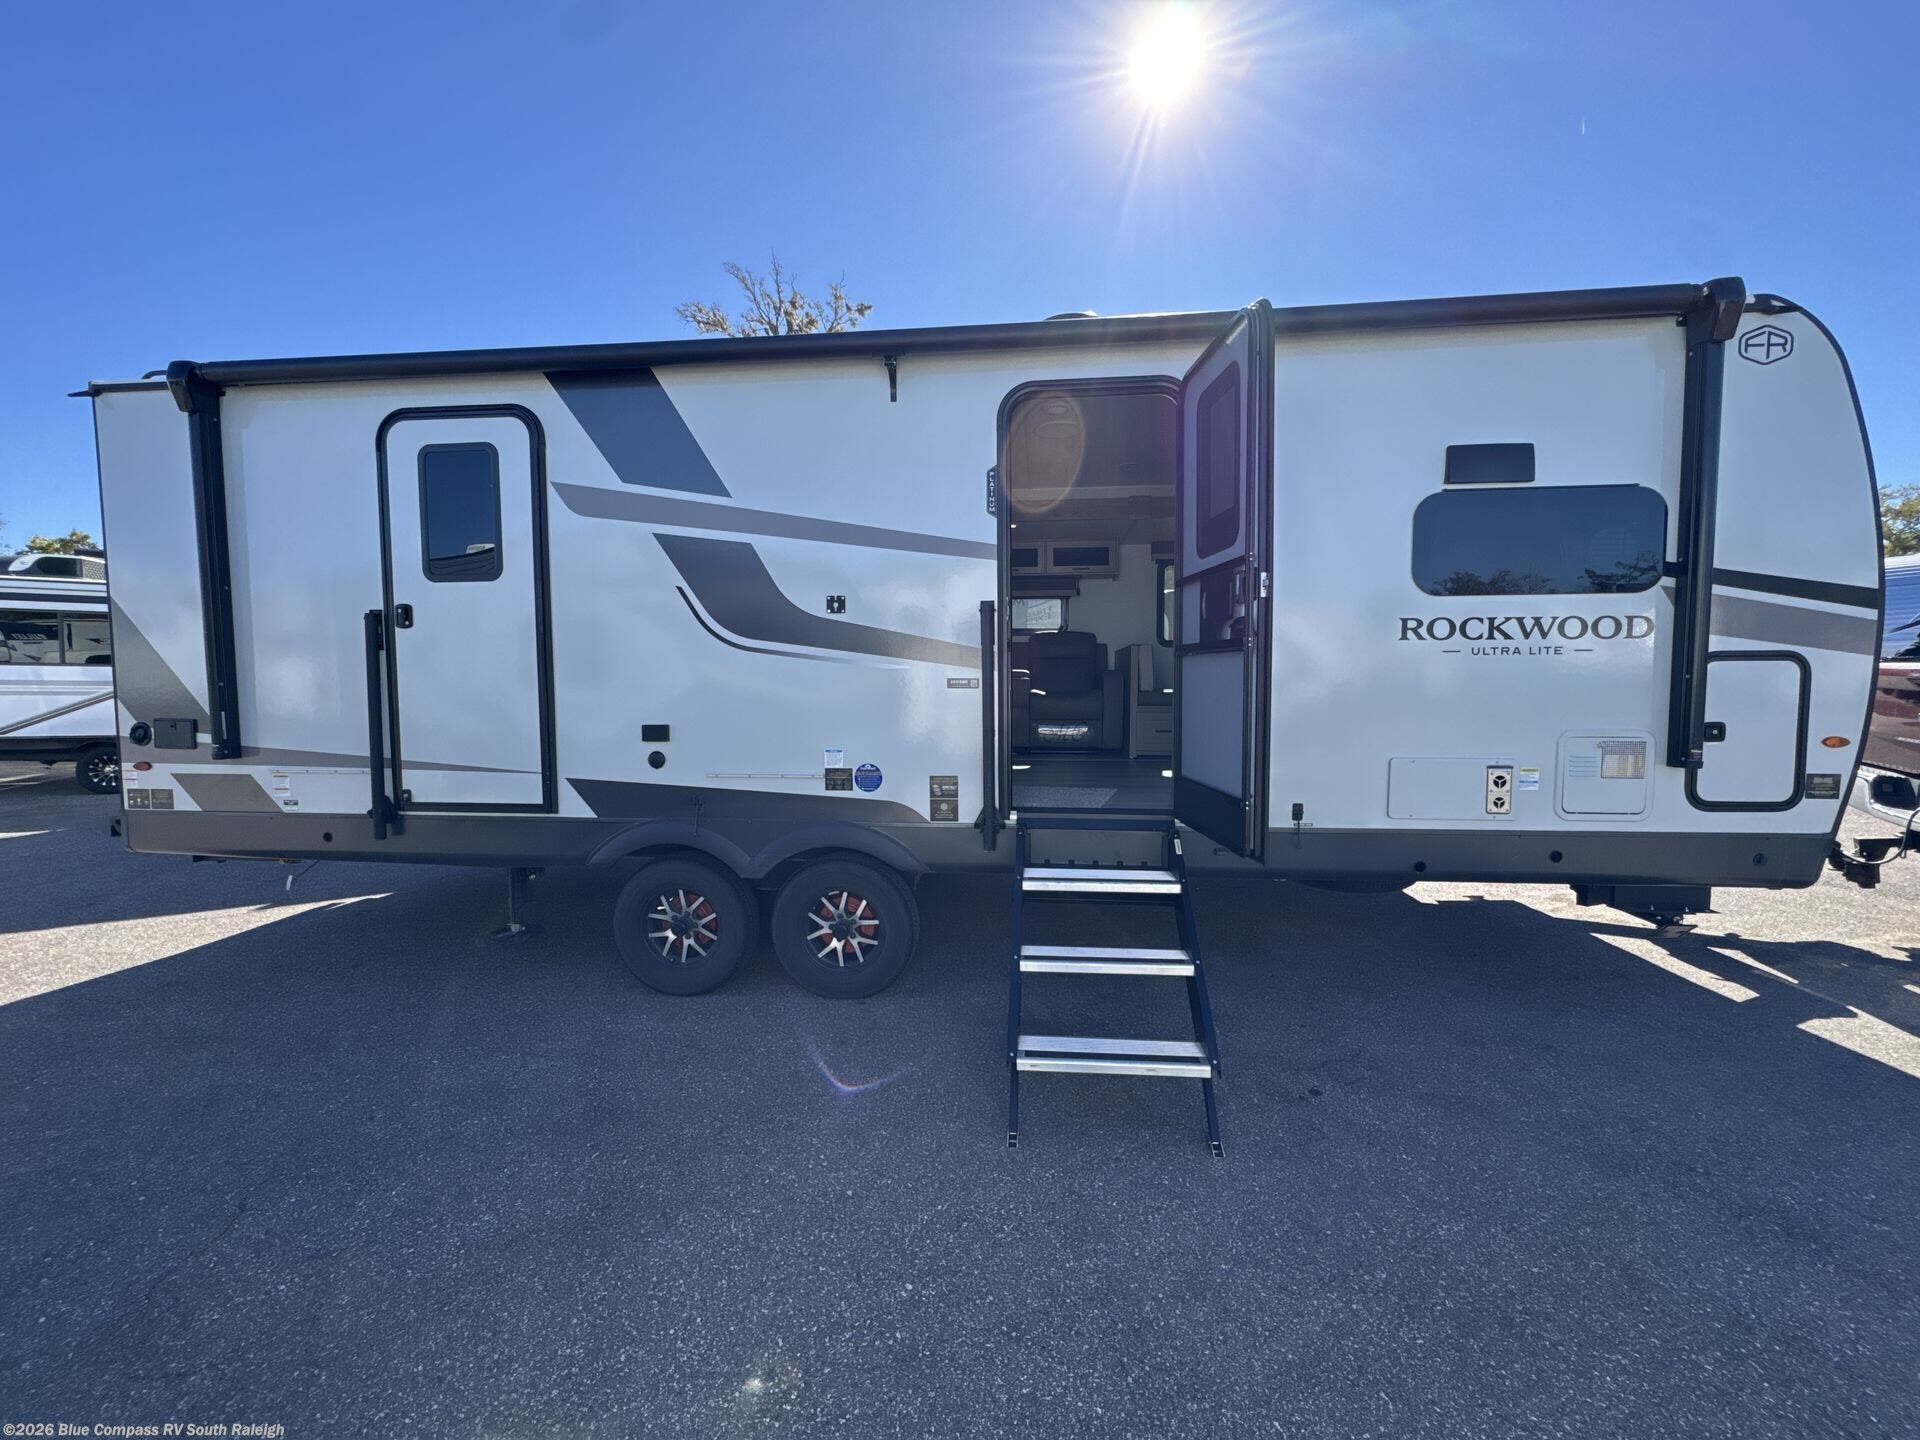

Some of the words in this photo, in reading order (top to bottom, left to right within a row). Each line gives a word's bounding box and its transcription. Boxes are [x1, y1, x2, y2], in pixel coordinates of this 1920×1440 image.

[1398, 615, 1655, 641] ROCKWOOD
[1471, 647, 1522, 656] ULTRA
[1528, 646, 1564, 655] LITE
